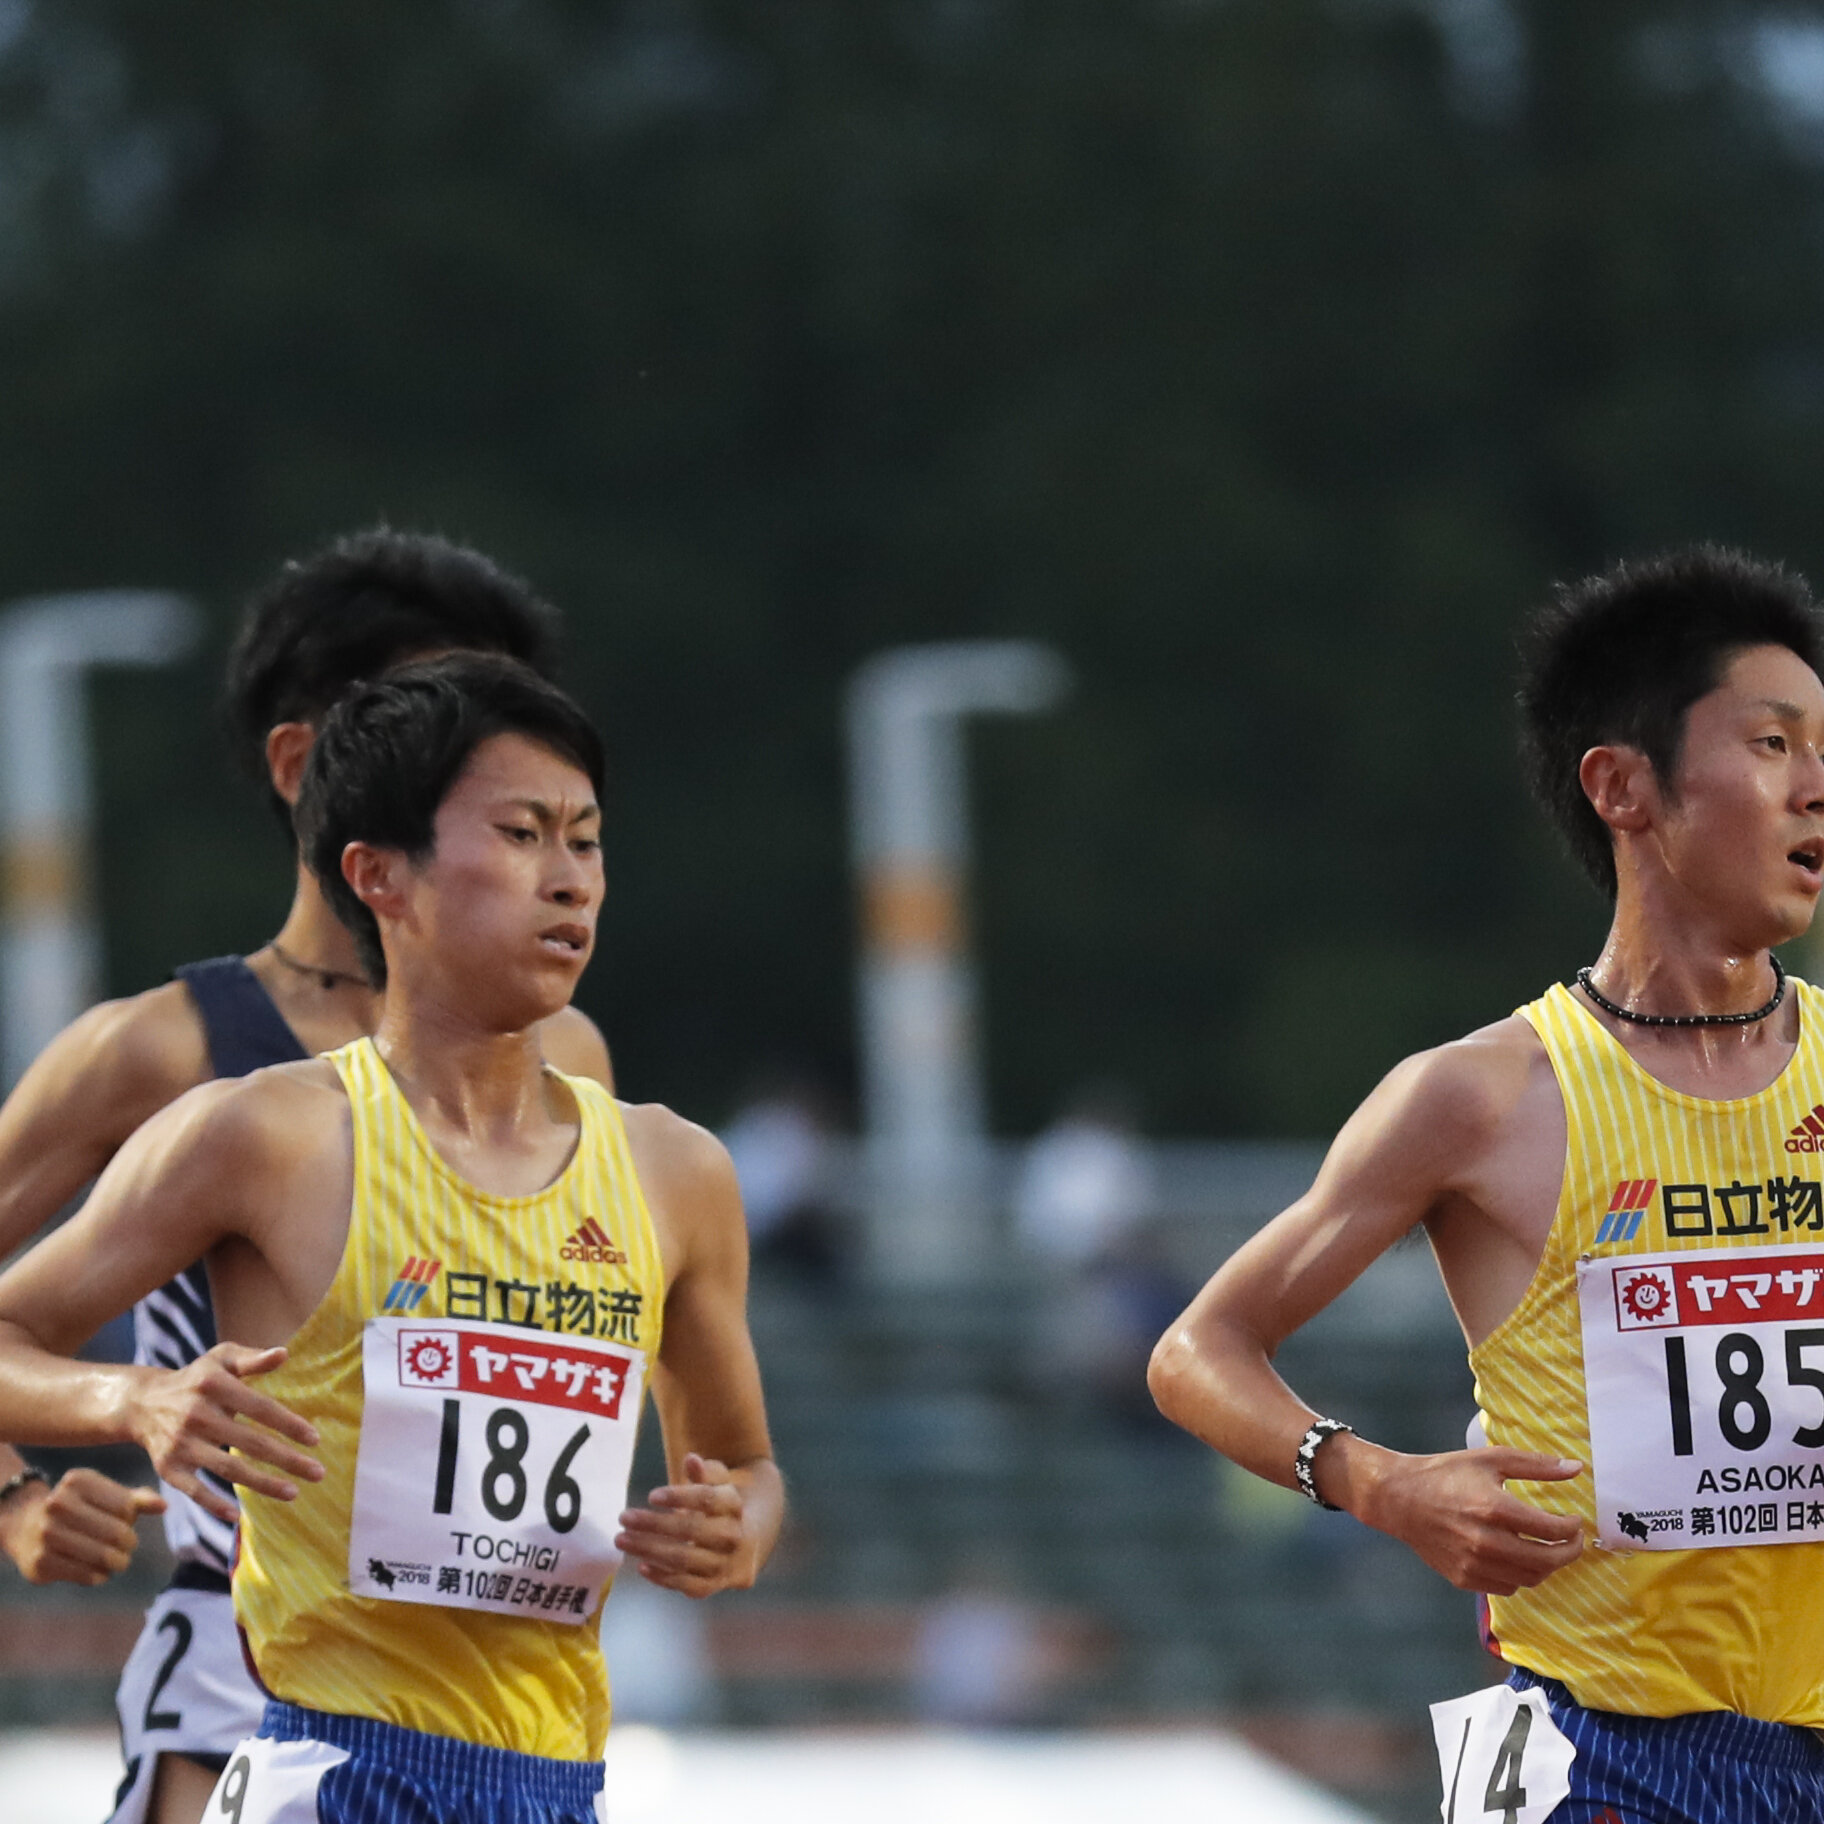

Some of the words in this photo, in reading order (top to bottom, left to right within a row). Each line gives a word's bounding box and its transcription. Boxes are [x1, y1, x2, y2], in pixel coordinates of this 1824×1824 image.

[560, 1246, 627, 1264] adidas
[446, 1271, 643, 1343] 日立物流
[469, 1345, 619, 1405] ヤマザキ
[433, 1399, 591, 1535] 186
[1636, 1509, 1683, 1519] YAMAGUCHI
[1650, 1519, 1685, 1532] 2018
[1690, 1504, 1778, 1537] 第102回
[450, 1531, 560, 1573] TOCHIGI
[398, 1570, 431, 1586] 2018
[144, 1610, 193, 1731] 2
